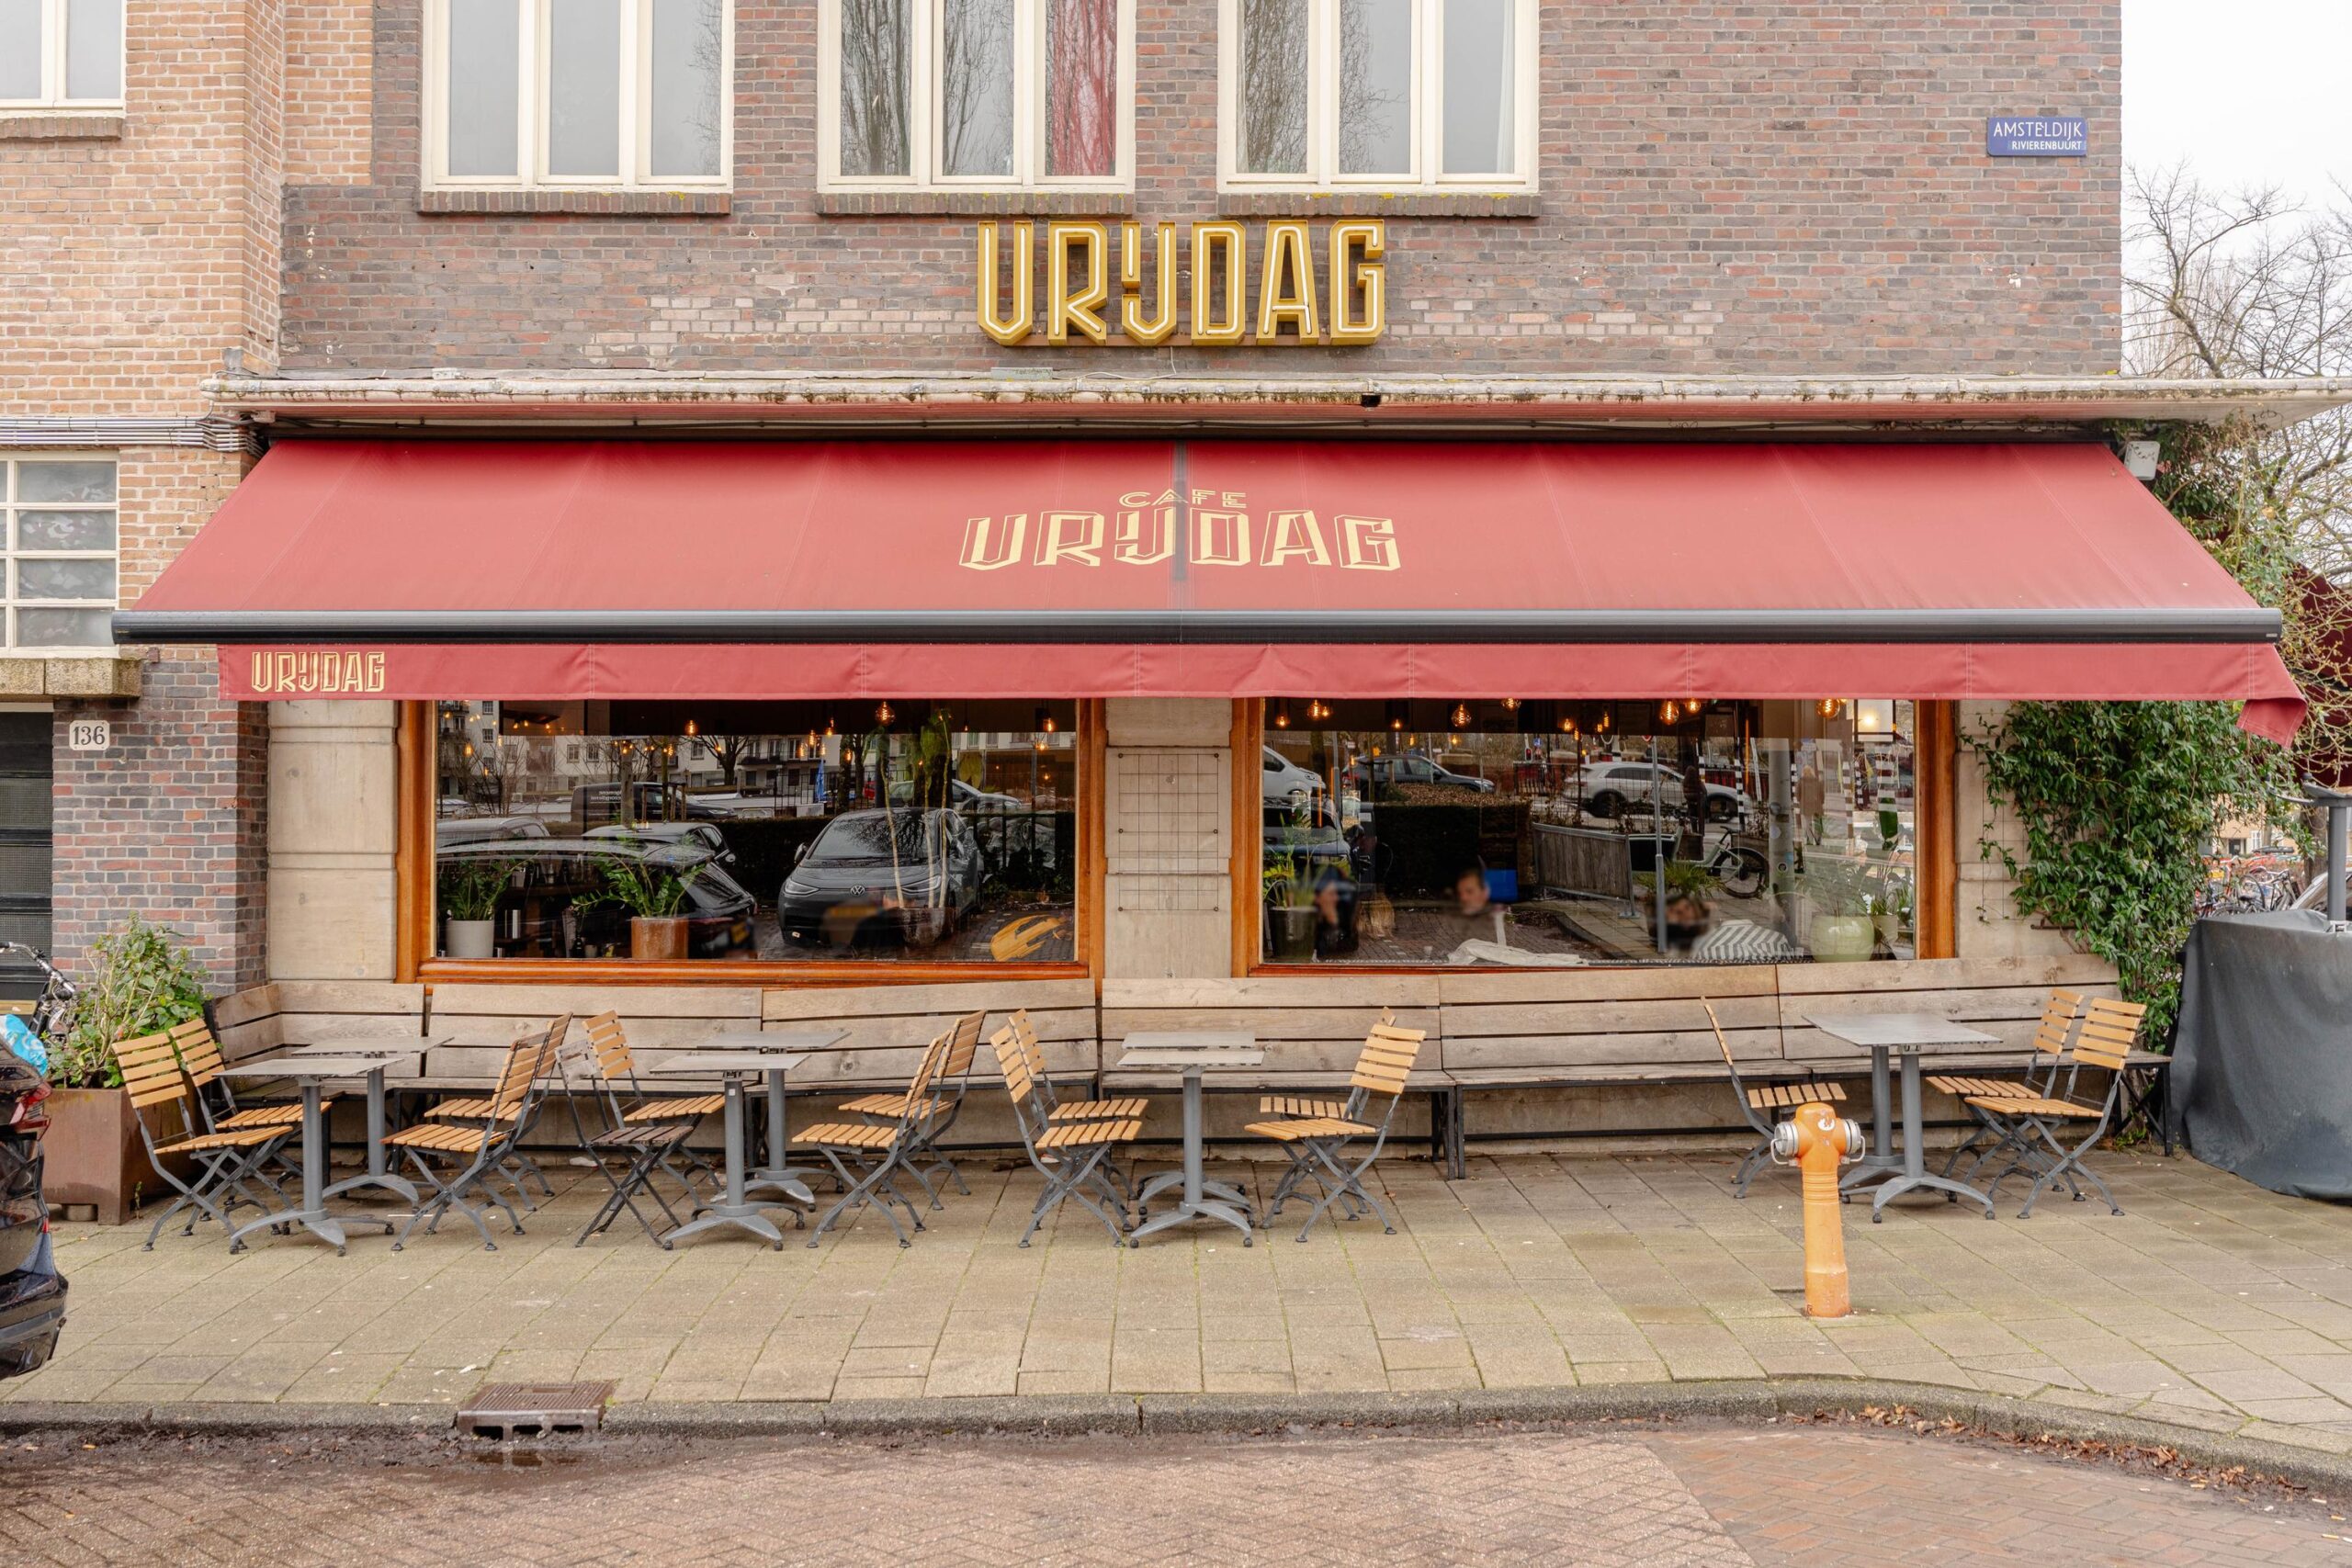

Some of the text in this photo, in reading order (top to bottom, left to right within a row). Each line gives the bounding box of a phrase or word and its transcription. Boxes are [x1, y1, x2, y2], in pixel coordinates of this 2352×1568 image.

[1994, 121, 2083, 141] AMSTELDIJK
[2011, 141, 2082, 151] RIVIERENBUURT
[1118, 488, 1248, 509] CAFE
[73, 725, 107, 745] 136
